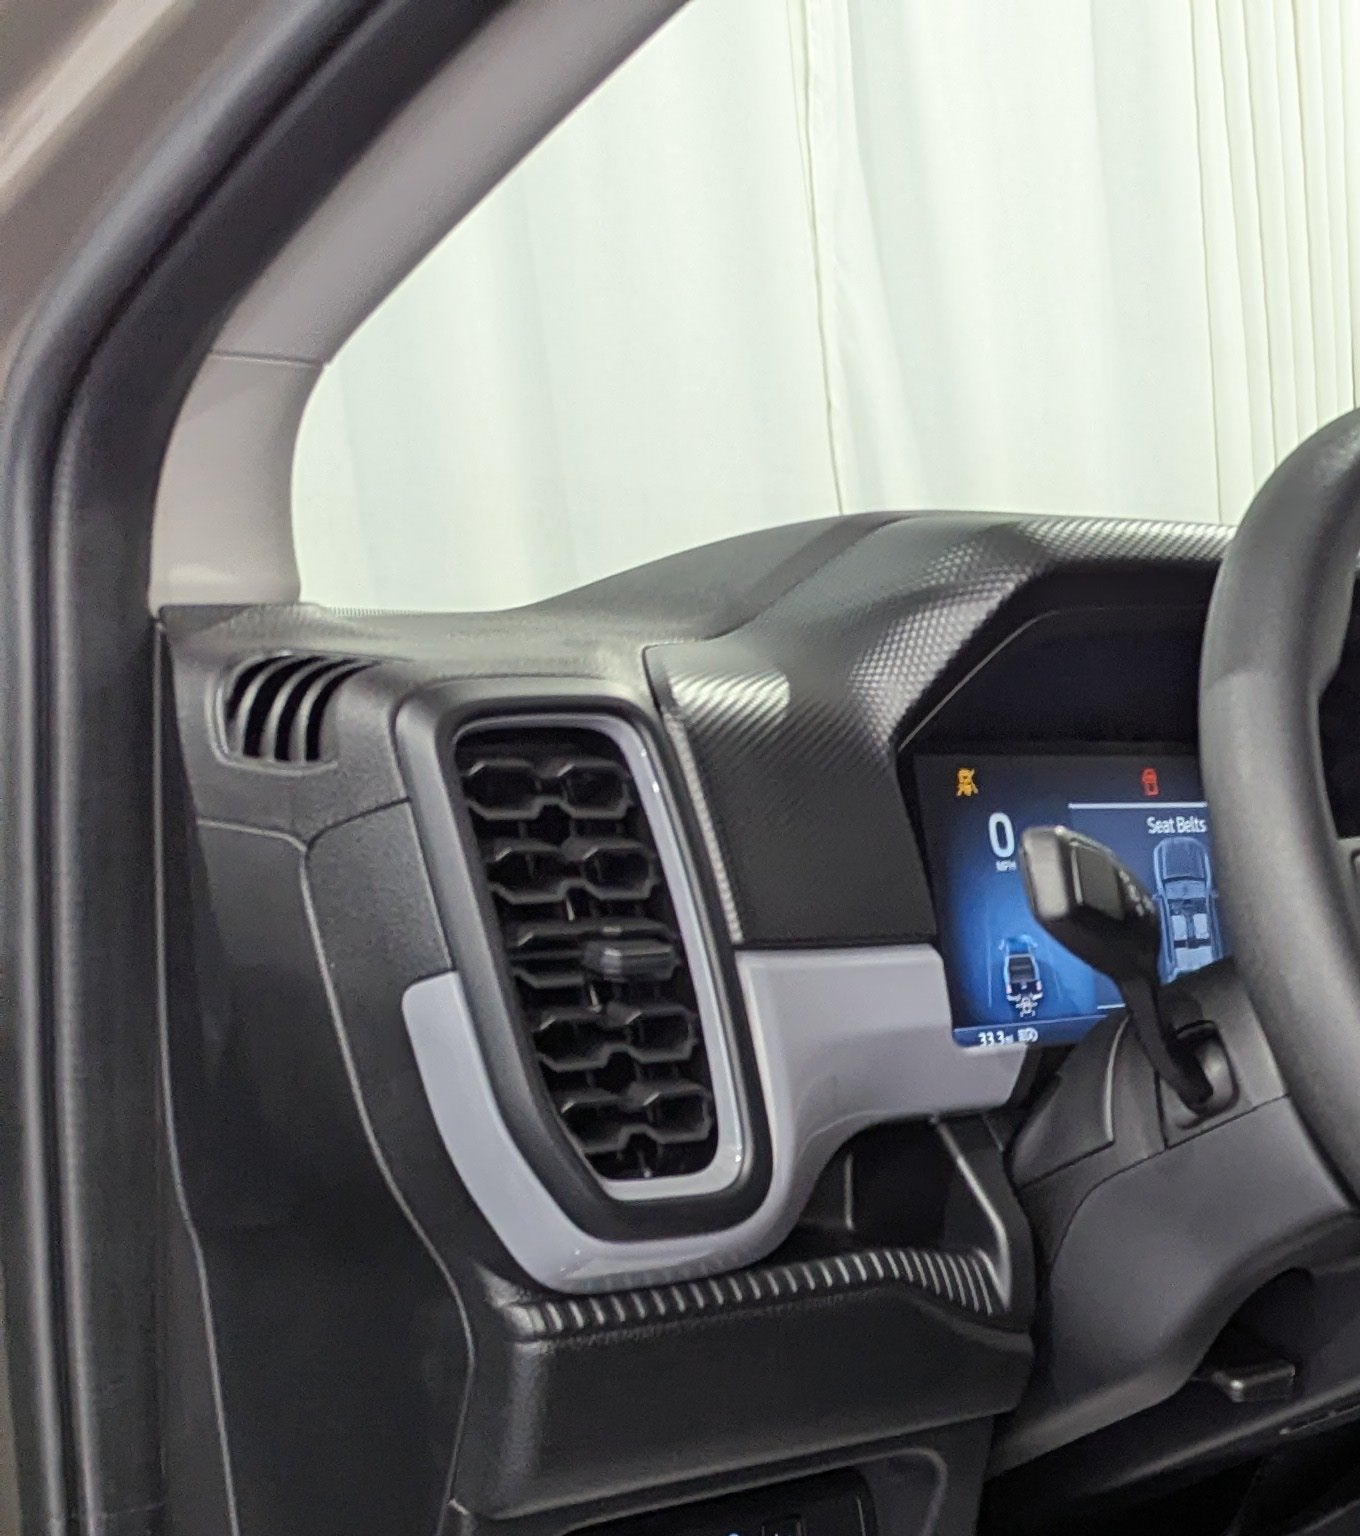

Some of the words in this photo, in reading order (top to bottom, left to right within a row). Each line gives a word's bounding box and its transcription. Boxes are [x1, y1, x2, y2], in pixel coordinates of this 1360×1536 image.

[988, 811, 1015, 858] 0
[1146, 815, 1176, 834] Seat
[1176, 815, 1208, 833] Belts
